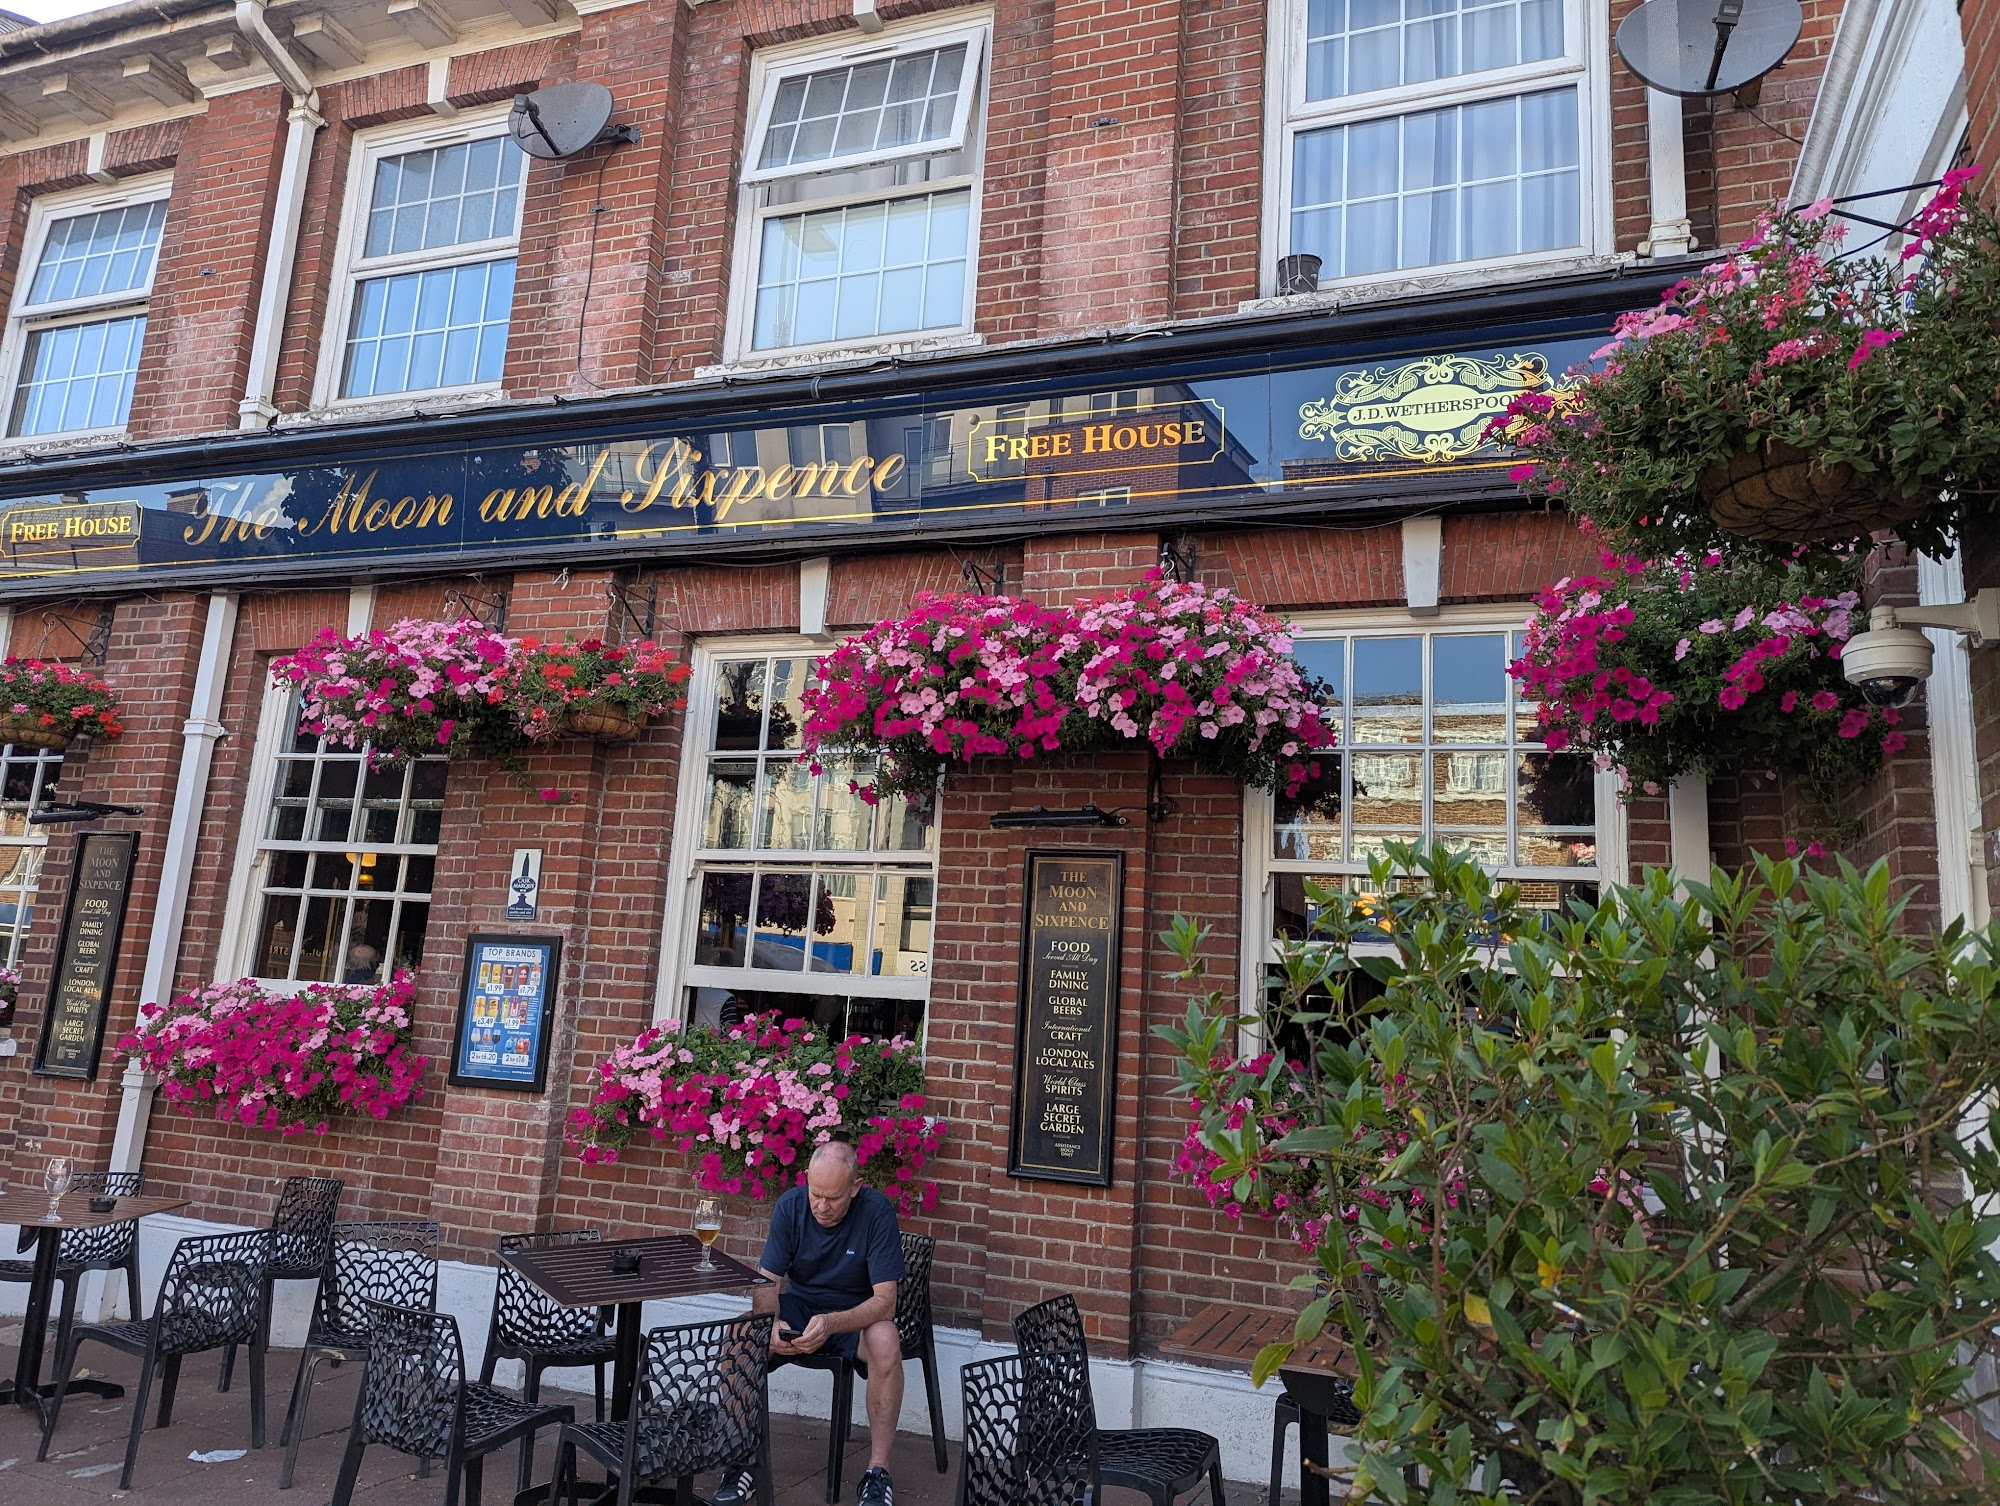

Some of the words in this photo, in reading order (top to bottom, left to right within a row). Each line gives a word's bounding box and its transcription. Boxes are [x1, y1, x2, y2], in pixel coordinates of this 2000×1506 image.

[985, 432, 1072, 463] FREE
[1081, 420, 1206, 454] HOUSE
[184, 481, 279, 546] The
[298, 467, 455, 537] Moon
[479, 448, 609, 523] and
[621, 436, 906, 521] Sixpence
[10, 522, 59, 543] FREE
[63, 516, 132, 538] HOUSE
[99, 847, 114, 856] THE
[90, 857, 120, 868] MOON
[94, 870, 111, 878] AND
[1060, 872, 1088, 882] THE
[79, 880, 122, 891] SIXPENCE
[1049, 885, 1098, 900] MOON
[84, 899, 108, 908] FOOD
[1058, 902, 1087, 912] AND
[81, 920, 104, 929] FAMILY
[1035, 914, 1109, 930] SIXPENCE
[80, 928, 104, 936] DINING
[78, 940, 100, 948] GLOBAL
[1051, 940, 1090, 952] FOOD
[488, 948, 504, 956] TOP
[506, 949, 536, 958] BRANDS
[1042, 950, 1067, 961] Served
[1066, 953, 1082, 962] All
[1082, 954, 1098, 966] Day
[75, 966, 94, 974] CRAFT
[1050, 970, 1088, 981] FAMILY
[69, 978, 96, 987] LONDON
[1048, 980, 1089, 990] DINING
[1048, 996, 1088, 1007] GLOBAL
[66, 1006, 88, 1014] SPIRITS
[1053, 1005, 1082, 1016] BEERS
[64, 1020, 84, 1028] LARGE
[1041, 1020, 1093, 1032] International
[62, 1026, 84, 1035] SECRET
[1050, 1030, 1082, 1042] CRAFT
[60, 1034, 86, 1042] GARDEN
[1042, 1048, 1089, 1059] LONDON
[1036, 1056, 1068, 1068] LOCAL
[1070, 1060, 1095, 1070] ALES
[1042, 1074, 1068, 1086] World
[1067, 1076, 1086, 1088] Class
[1044, 1084, 1083, 1096] SPIRITS
[1046, 1102, 1080, 1114] LARGE
[1043, 1112, 1082, 1124] SECRET
[1040, 1122, 1085, 1134] GARDEN
